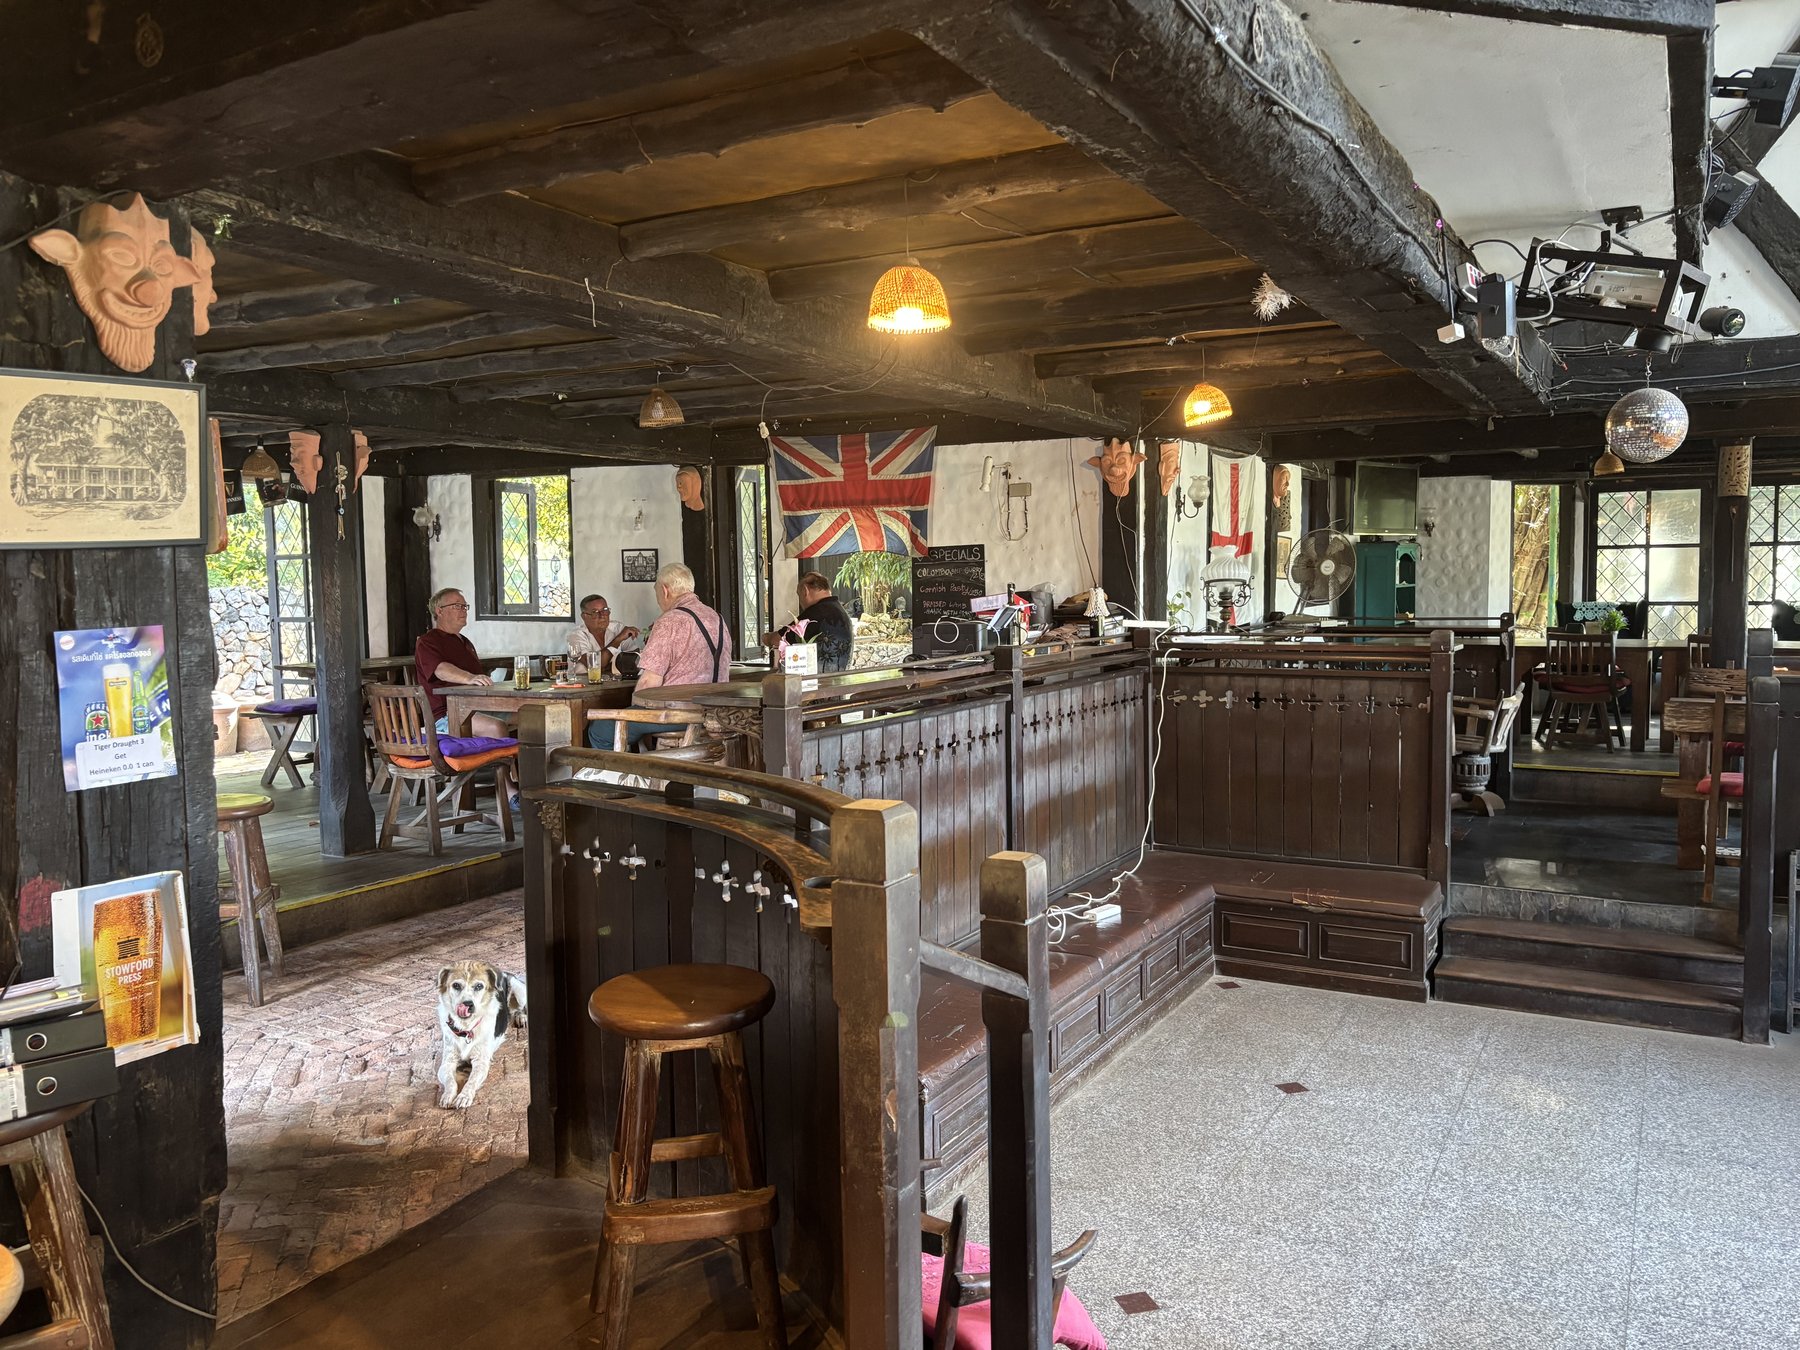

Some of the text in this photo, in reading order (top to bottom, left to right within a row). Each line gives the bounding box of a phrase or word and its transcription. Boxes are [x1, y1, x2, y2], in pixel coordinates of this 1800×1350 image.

[930, 547, 981, 561] SPECIALS
[920, 583, 946, 592] Cornish
[94, 743, 111, 751] Tiger
[112, 739, 139, 749] Draught
[89, 765, 121, 776] Heineken
[105, 957, 154, 979] STOWFORD
[118, 972, 142, 985] PRESS
